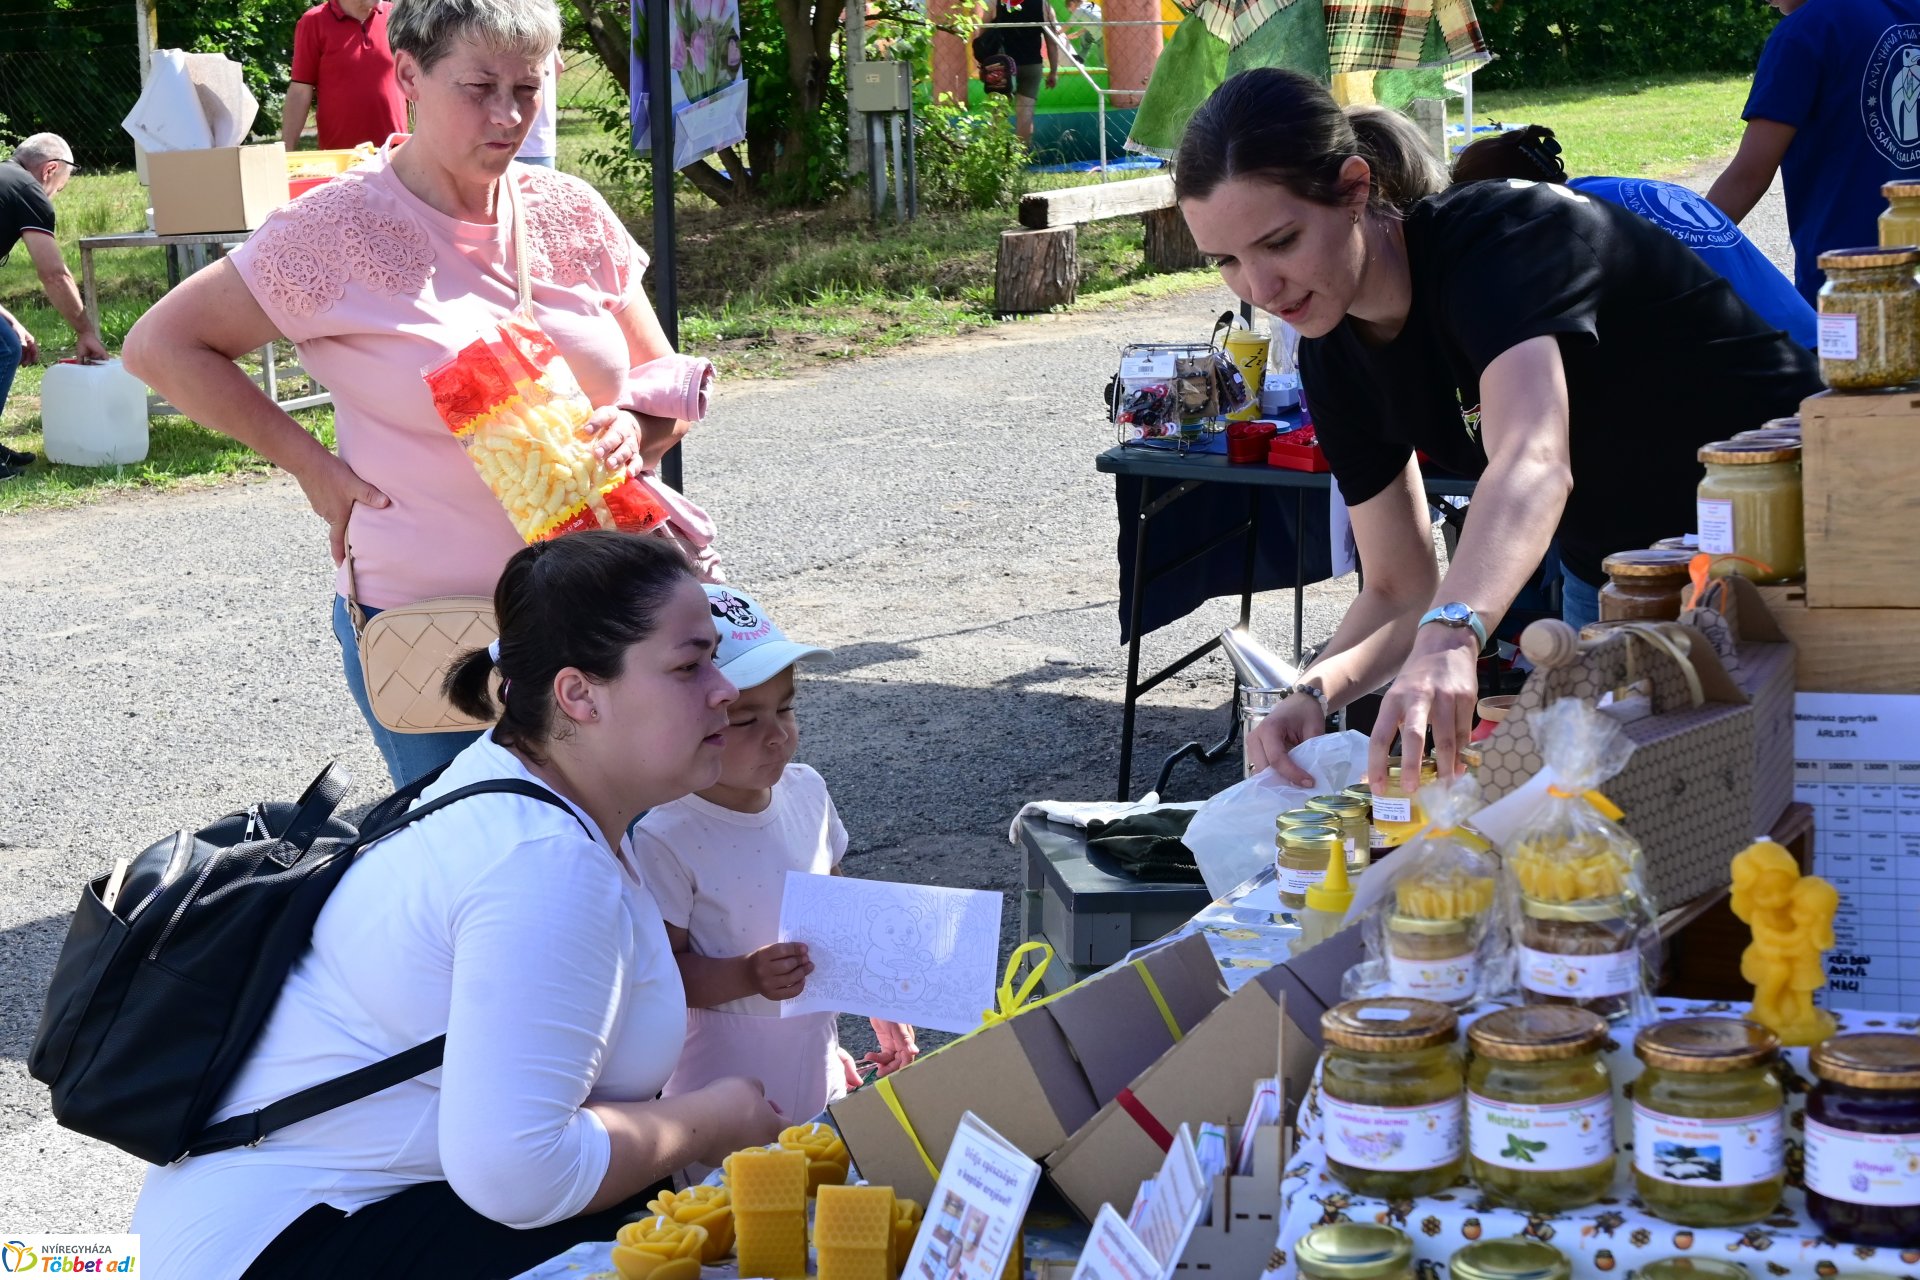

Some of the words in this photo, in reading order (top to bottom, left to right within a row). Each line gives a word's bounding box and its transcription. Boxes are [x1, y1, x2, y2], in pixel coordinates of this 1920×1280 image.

[1868, 111, 1897, 156] KOCSÁNY
[1660, 225, 1704, 243] OCSÁNY
[1817, 728, 1857, 738] ÁRLISTA
